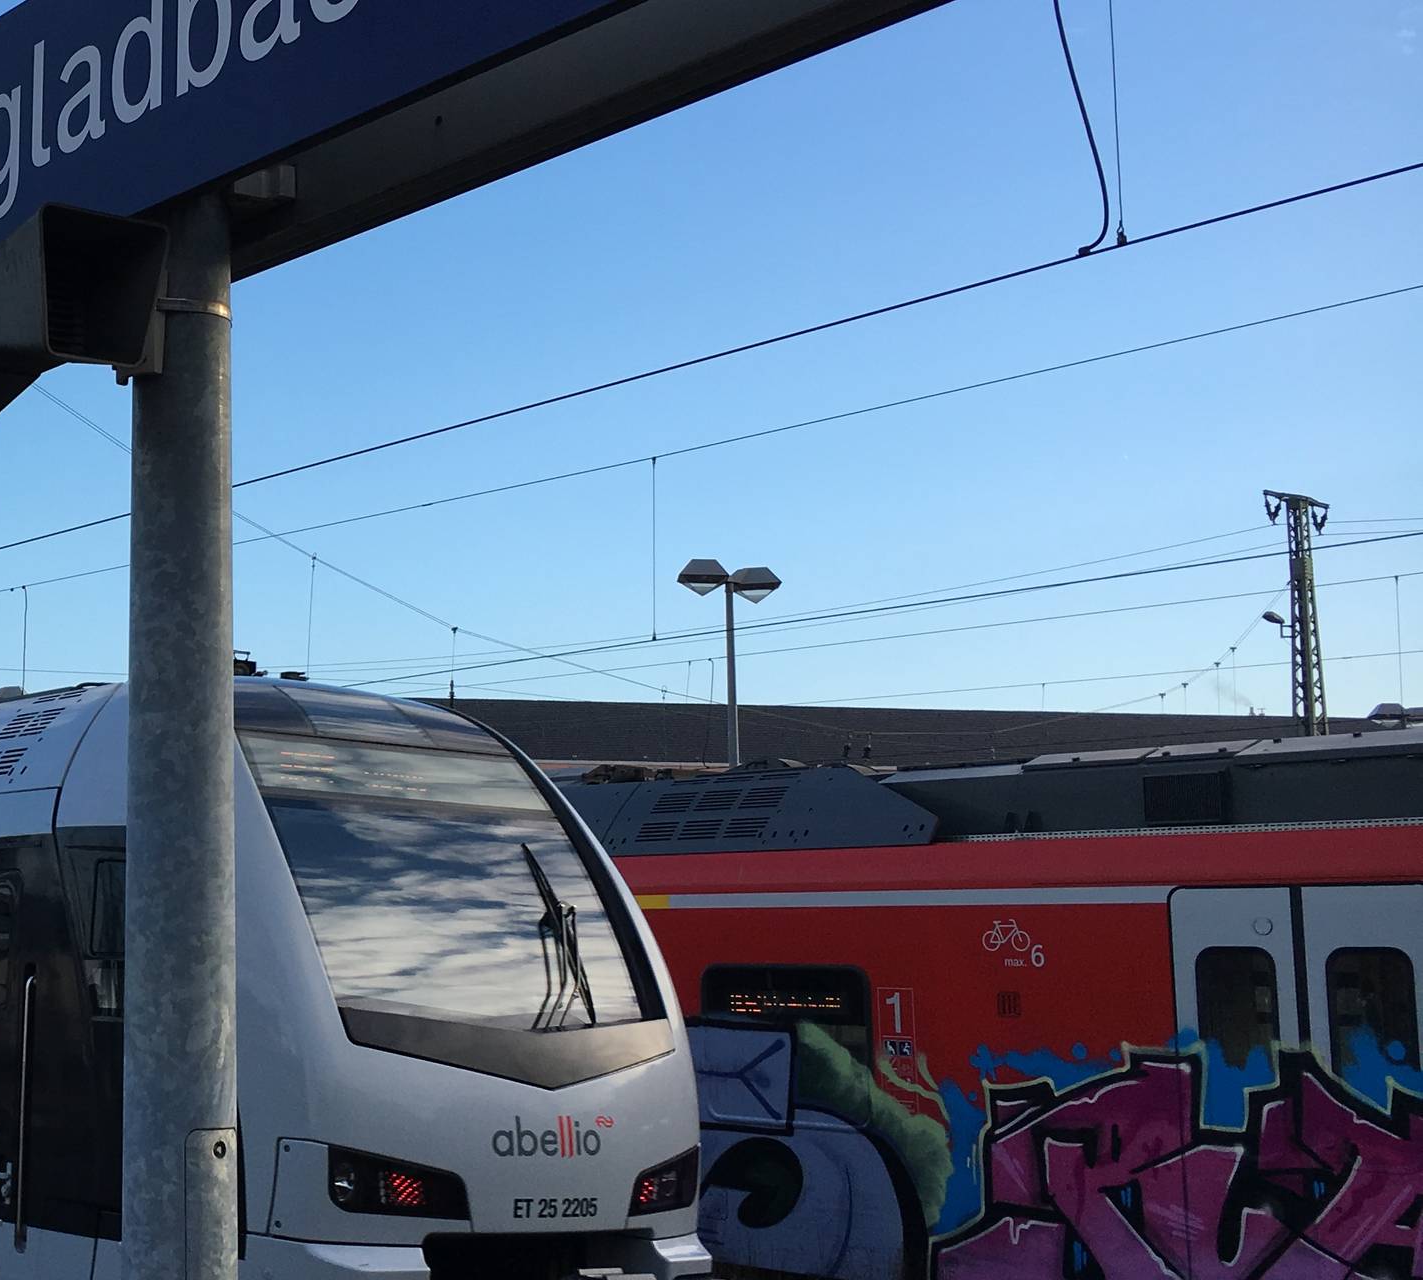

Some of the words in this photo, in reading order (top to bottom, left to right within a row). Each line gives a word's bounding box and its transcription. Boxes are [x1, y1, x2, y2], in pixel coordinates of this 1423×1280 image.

[1004, 958, 1027, 967] max.
[1030, 943, 1045, 968] 6
[885, 991, 902, 1034] 1
[492, 1115, 601, 1158] abellio
[513, 1198, 534, 1218] ET
[537, 1198, 558, 1218] 25
[562, 1197, 598, 1218] 2205
